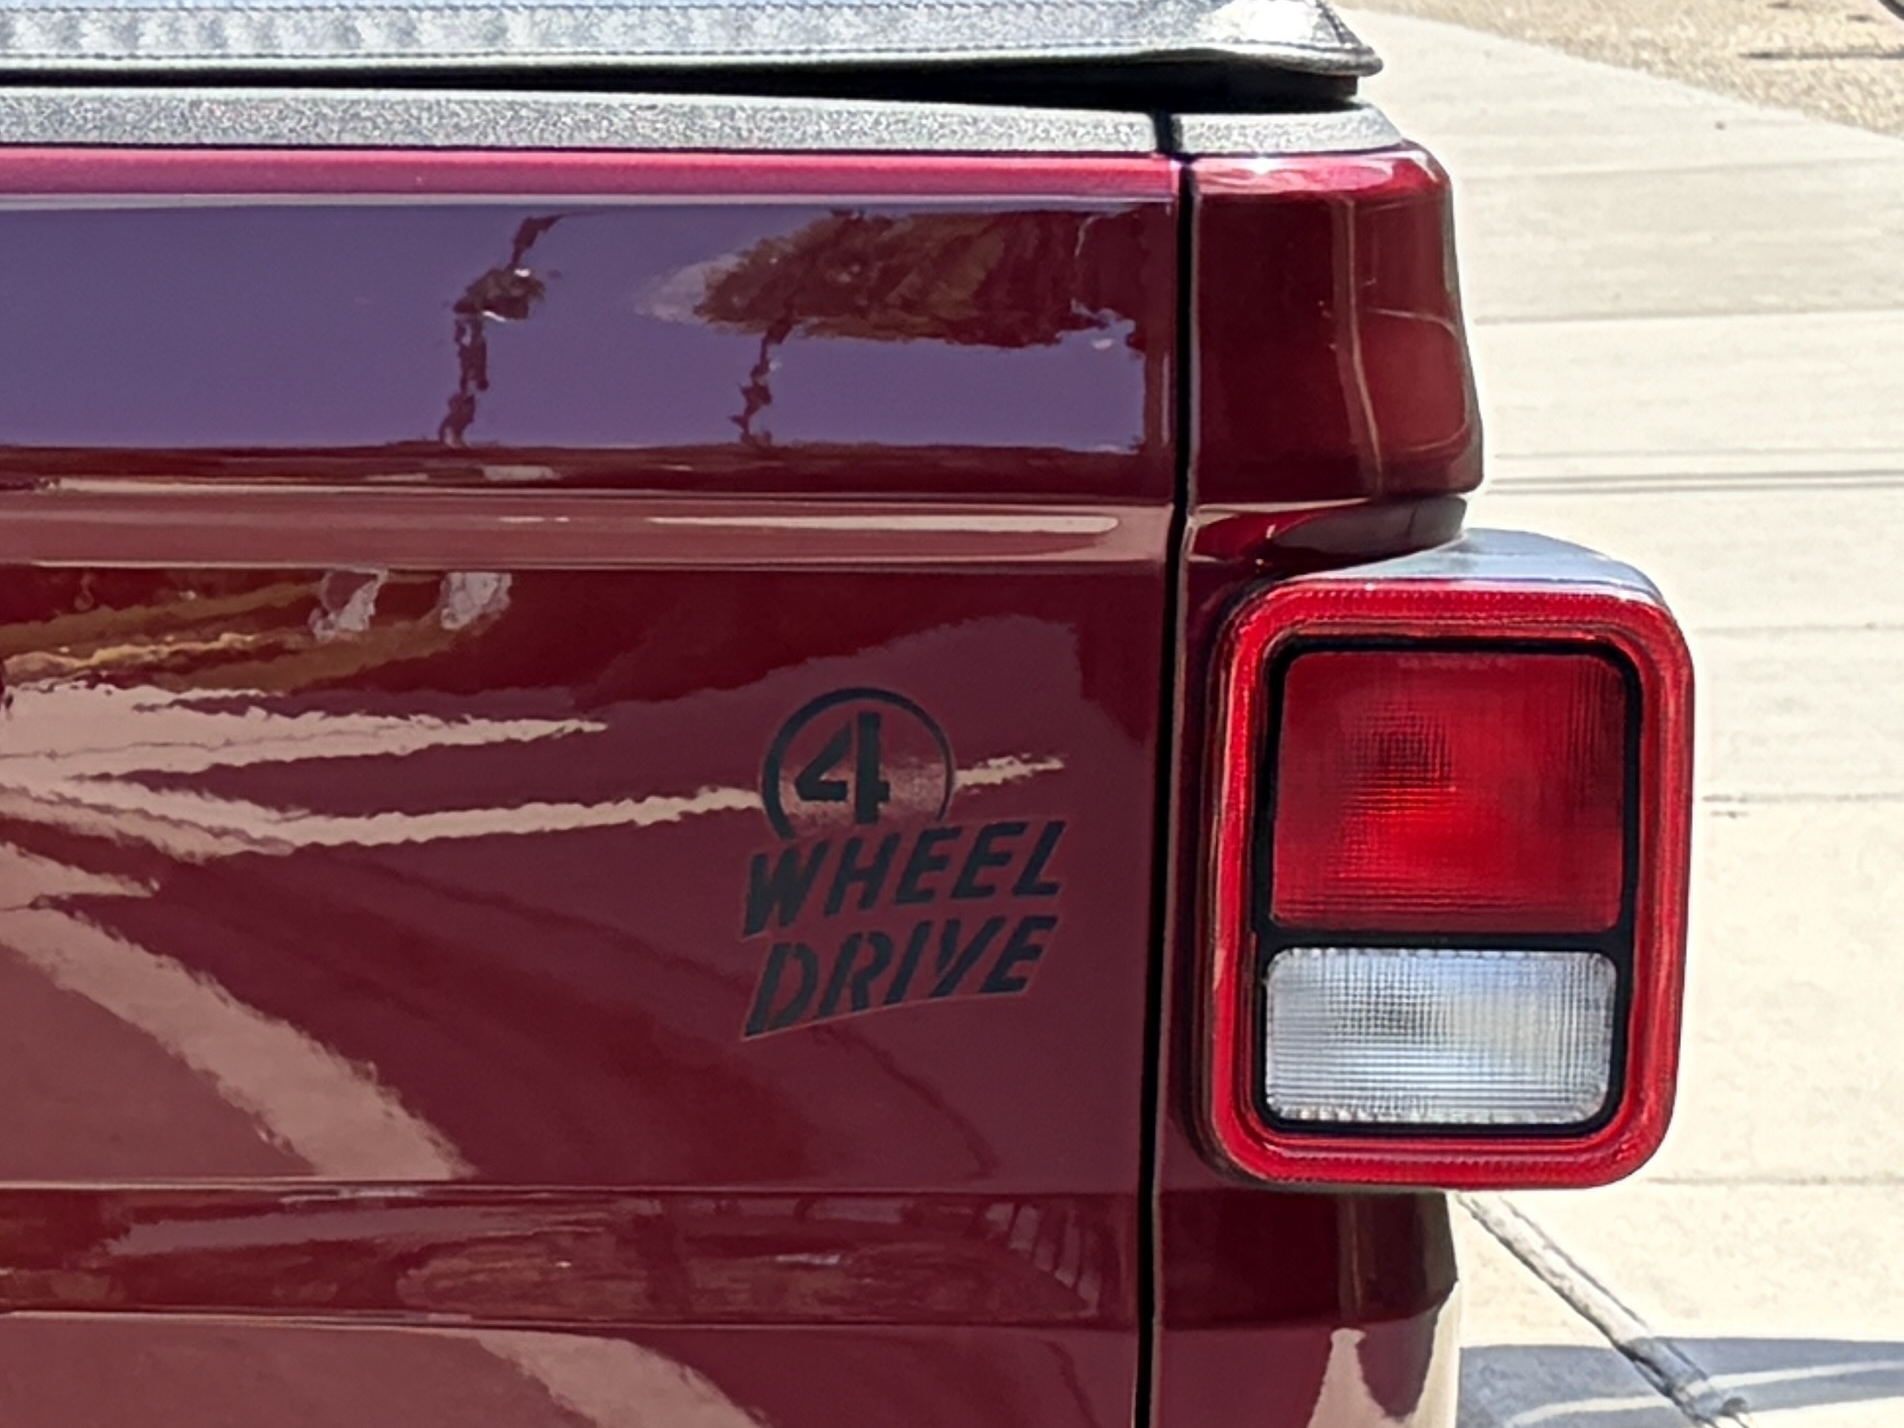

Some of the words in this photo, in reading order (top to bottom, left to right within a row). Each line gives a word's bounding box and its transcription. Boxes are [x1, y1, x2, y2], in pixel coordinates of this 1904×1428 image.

[794, 710, 891, 826] 4
[742, 819, 1067, 940] WHEEL
[742, 914, 1059, 1039] DRIVE
